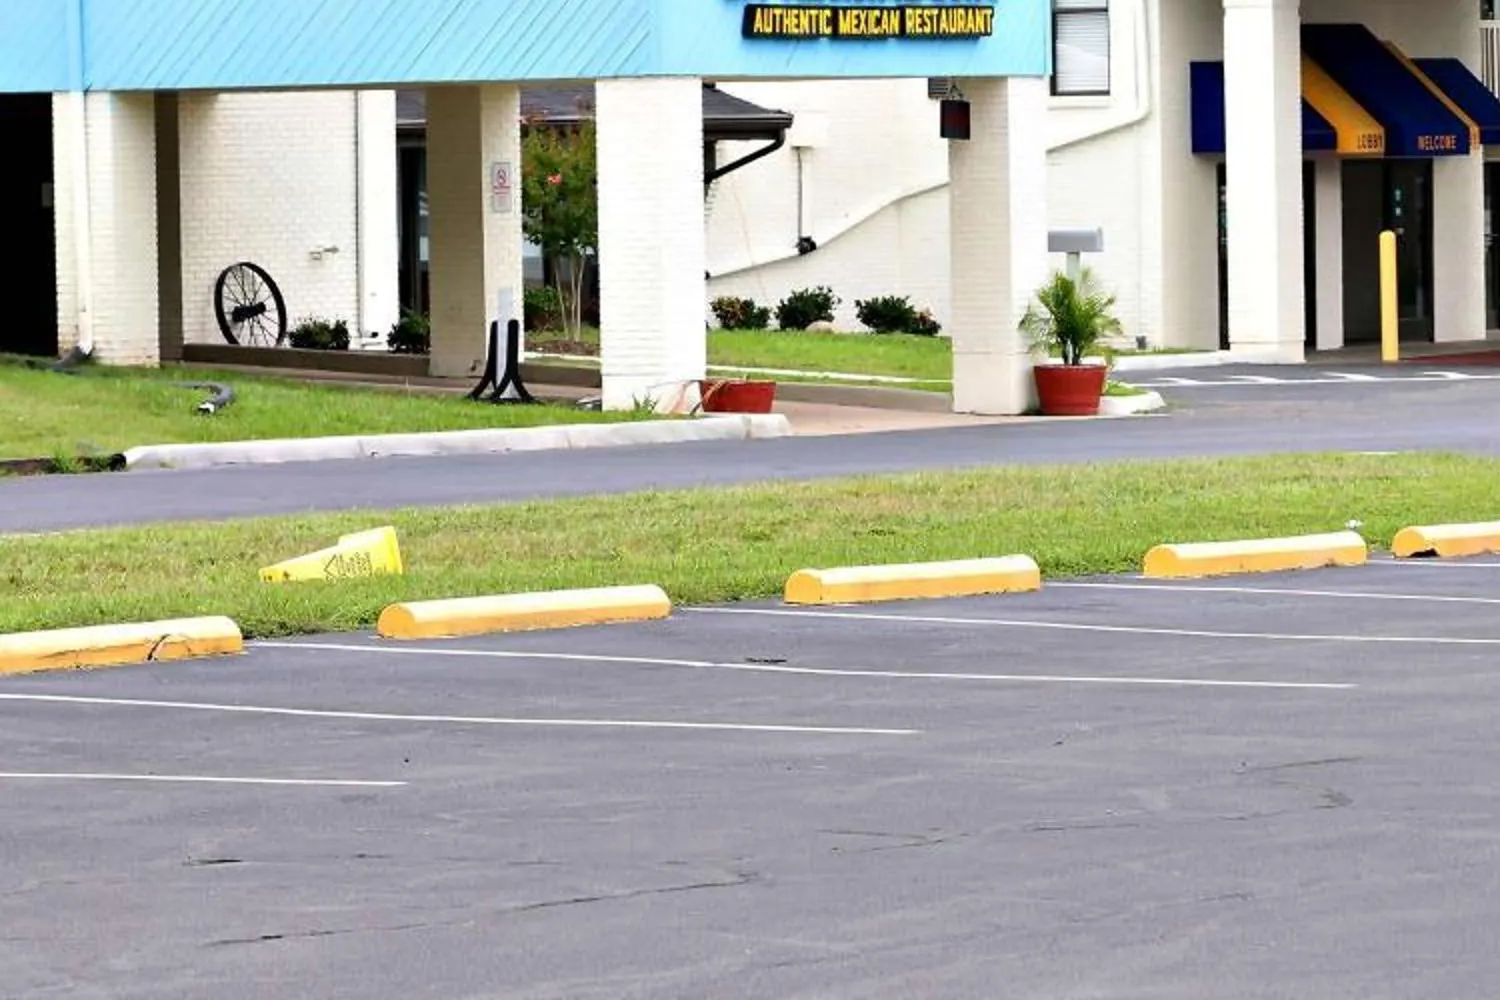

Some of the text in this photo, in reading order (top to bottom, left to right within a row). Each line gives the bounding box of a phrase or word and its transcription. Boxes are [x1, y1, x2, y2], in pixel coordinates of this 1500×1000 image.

[753, 7, 994, 35] AUTHENTIC MEXICAN RESTAURANT
[1417, 135, 1457, 150] WELCOME
